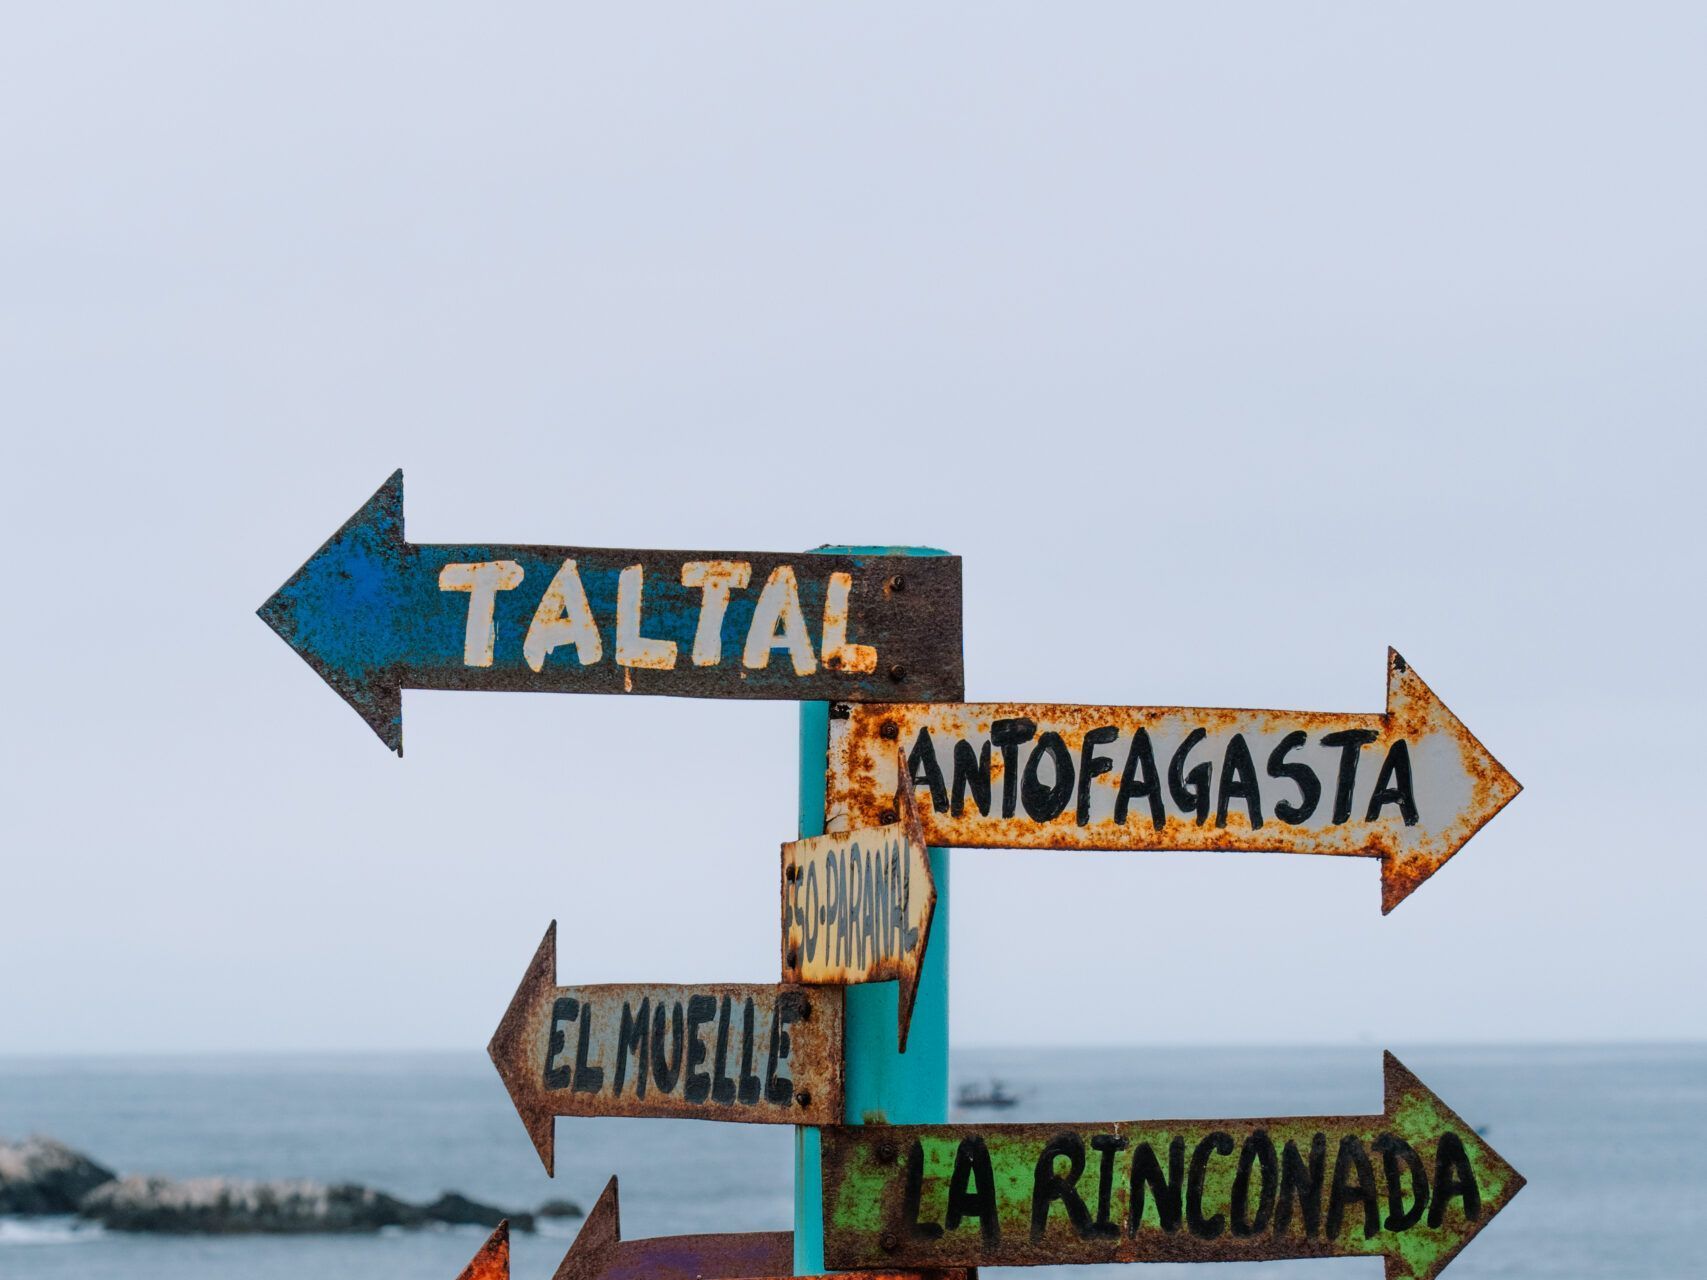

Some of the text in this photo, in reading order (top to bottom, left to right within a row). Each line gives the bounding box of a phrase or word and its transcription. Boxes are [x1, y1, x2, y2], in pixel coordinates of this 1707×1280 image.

[438, 559, 878, 676] TALTAL
[907, 716, 1421, 831] ANTOFAGASTA
[544, 991, 806, 1107] EL MUELLE
[906, 1129, 1482, 1248] LA RINCONADA
